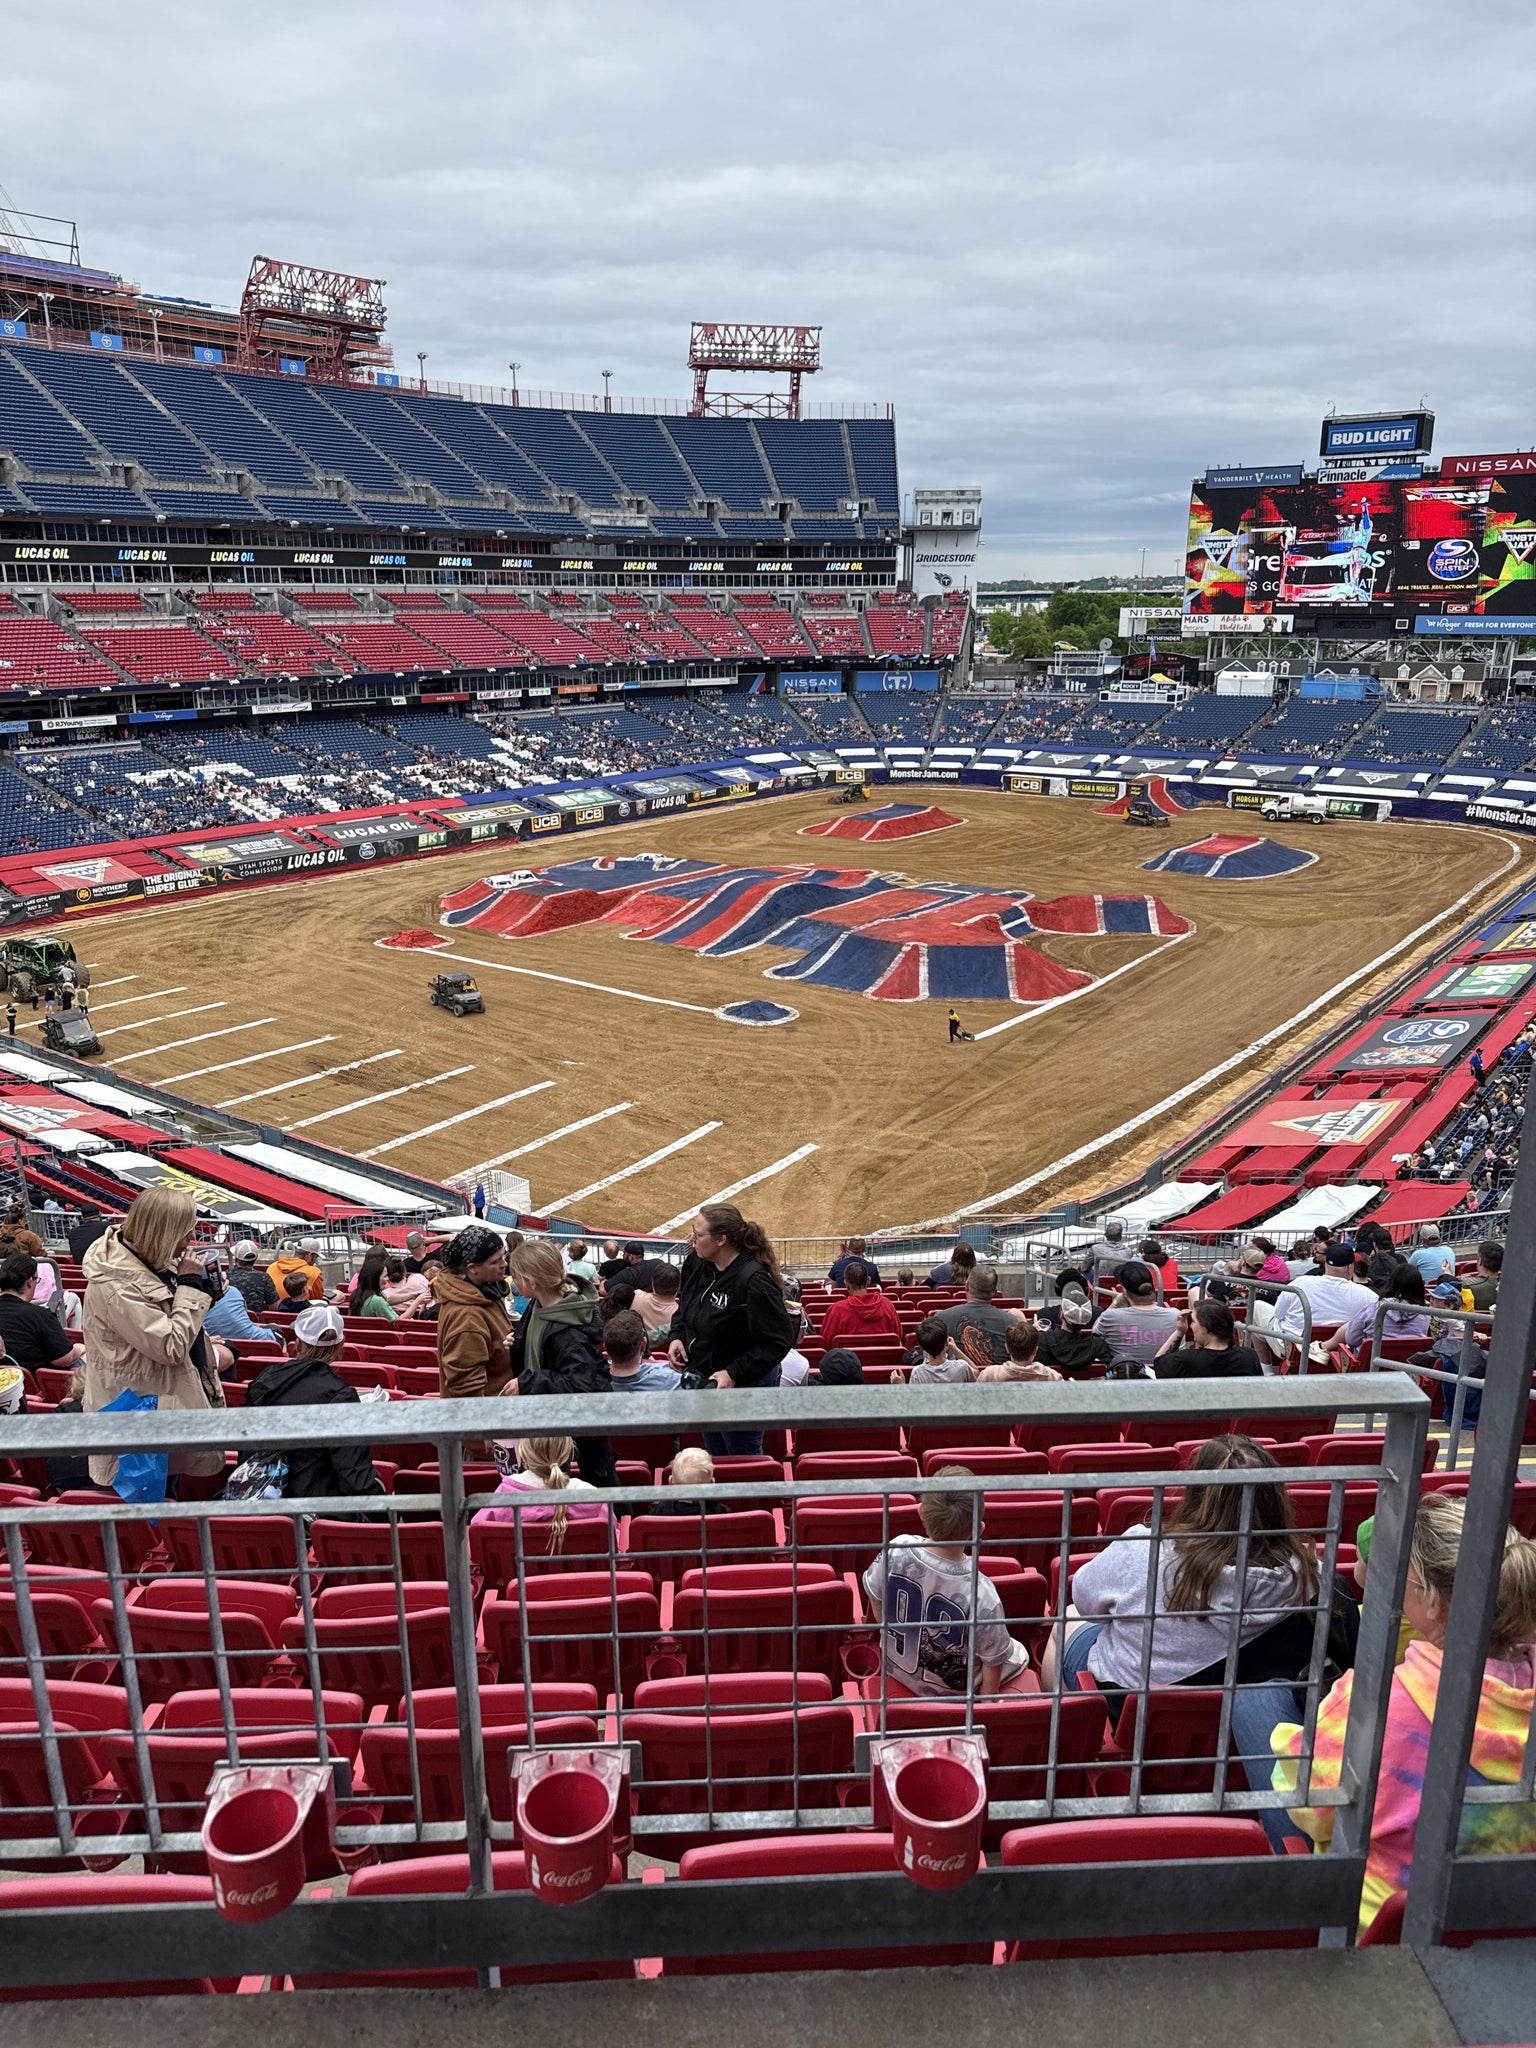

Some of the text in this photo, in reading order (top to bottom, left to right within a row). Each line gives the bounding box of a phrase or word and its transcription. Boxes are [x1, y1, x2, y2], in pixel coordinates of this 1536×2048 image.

[1332, 429, 1412, 445] BUD LIGHT
[1455, 459, 1536, 473] NISSAN
[1213, 475, 1254, 483] VANDERBILT
[1319, 470, 1366, 482] Pinnacle
[15, 547, 70, 559] LUCAS OIL
[118, 550, 167, 561] LUCAS OIL
[211, 552, 255, 562] LUCAS OIL
[294, 553, 334, 563] LUCAS OIL
[915, 554, 976, 563] BRIDGESTONE
[369, 555, 407, 565] LUCAS OIL
[439, 557, 473, 566] LUCAS OIL
[502, 559, 533, 568] LUCAS OIL
[560, 561, 594, 570] LUCAS OIL
[1435, 558, 1470, 566] SPIN
[623, 562, 658, 570] LUCAS OIL
[688, 563, 712, 571] LUCAS
[850, 562, 863, 570] OIL
[1129, 608, 1183, 617] NISSAN
[1183, 616, 1209, 624] MARS
[1436, 618, 1461, 631] Kroger
[784, 678, 838, 687] NISSAN
[1065, 680, 1087, 691] lite
[76, 733, 100, 741] BLAND
[838, 772, 862, 780] JCB
[889, 770, 959, 779] MonsterJam.com
[729, 783, 750, 794] UNOH
[1013, 780, 1040, 789] JCB
[651, 794, 688, 810] LUCAS OIL
[1235, 795, 1258, 803] MORGAN
[1331, 800, 1363, 812] BKT
[578, 809, 602, 821] JCB
[534, 816, 560, 829] JCB
[333, 825, 388, 839] LUCAS
[472, 824, 498, 838] BKT
[419, 832, 447, 847] BKT
[239, 859, 283, 871] UTAH SPORTS
[287, 852, 326, 870] LUCAS
[239, 865, 283, 876] COMMISSION
[146, 868, 202, 886] THE ORIGINAL
[92, 883, 129, 894] NORTHERN
[145, 878, 200, 895] SUPER GLUE
[1460, 963, 1522, 996] BKT
